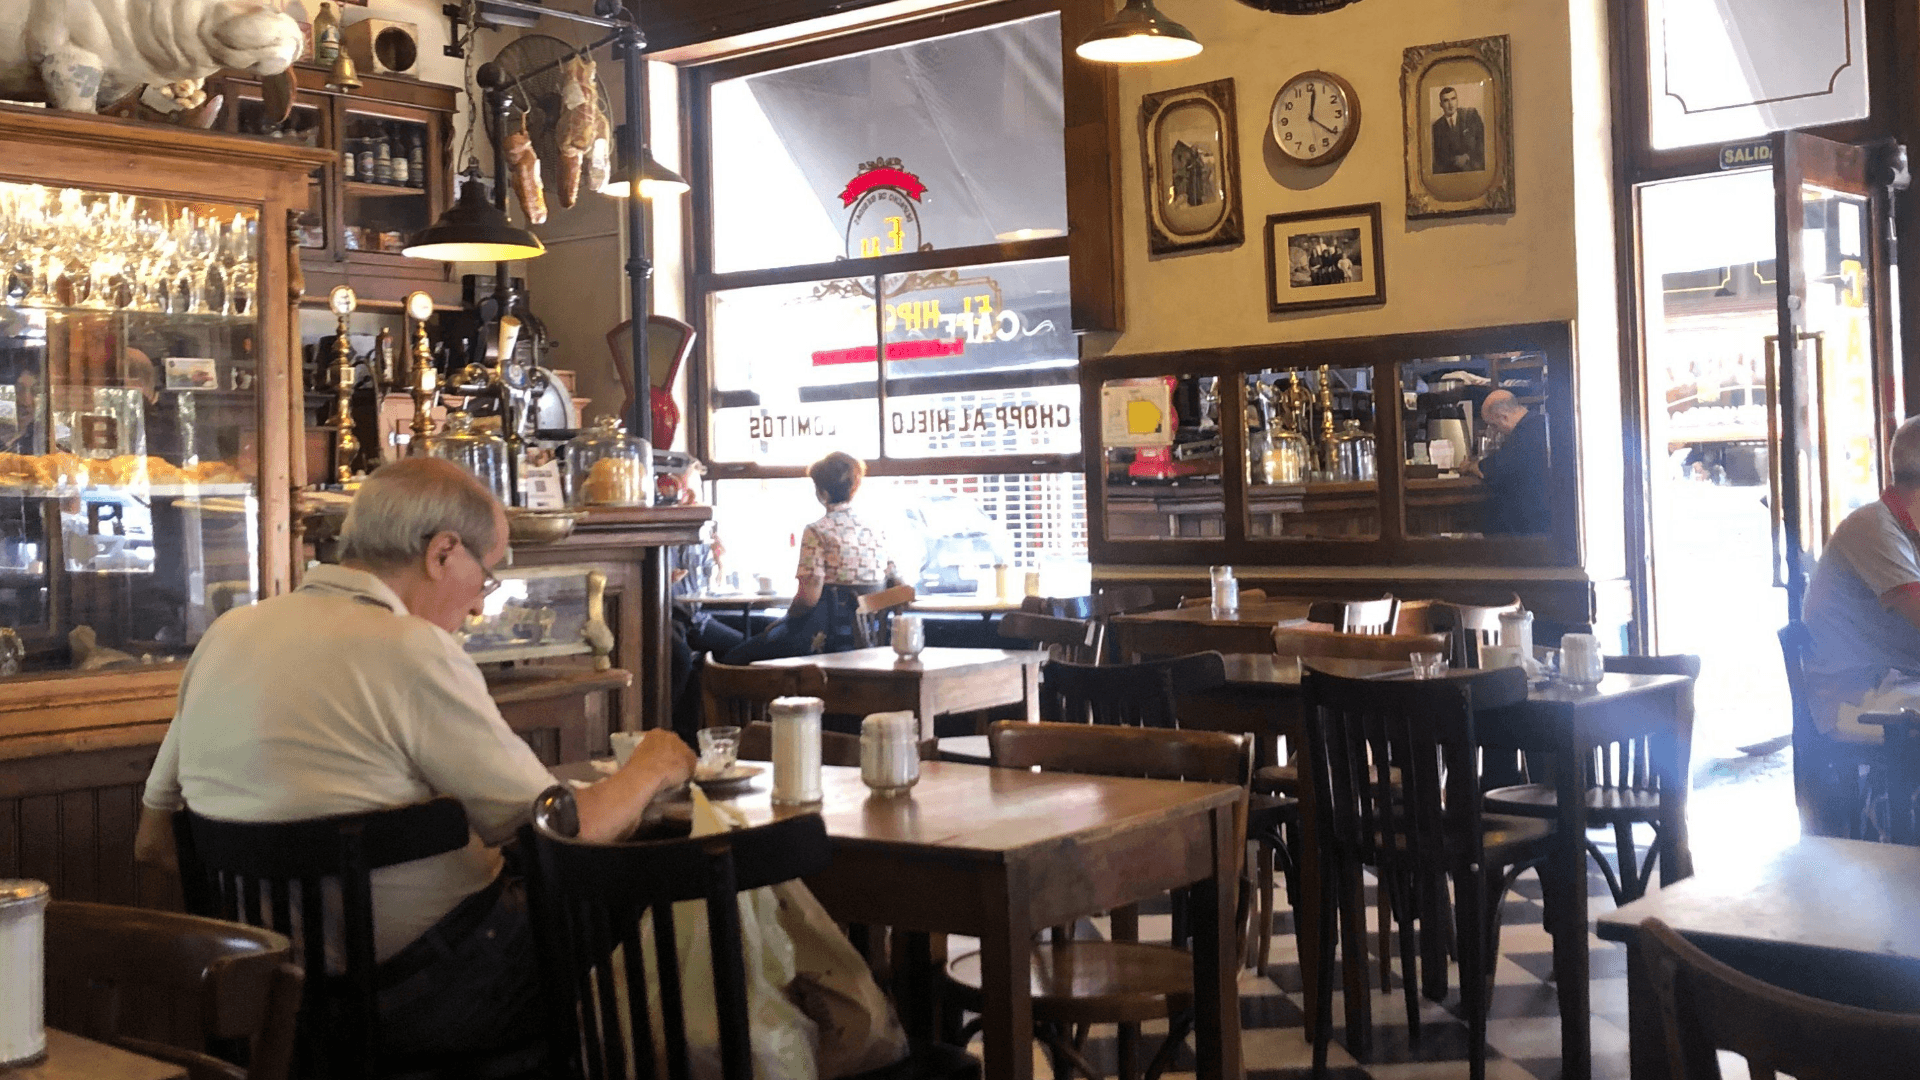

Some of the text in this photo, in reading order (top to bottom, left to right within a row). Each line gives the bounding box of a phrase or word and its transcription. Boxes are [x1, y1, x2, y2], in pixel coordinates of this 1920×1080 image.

[1306, 83, 1314, 92] 12
[1295, 89, 1302, 98] 11
[1330, 95, 1337, 104] 2
[1285, 102, 1293, 111] 10
[1334, 109, 1342, 119] 3
[1281, 117, 1289, 126] 9
[1331, 125, 1338, 134] 4
[1285, 132, 1293, 141] 8
[1295, 141, 1302, 151] 7
[1322, 137, 1330, 147] 5
[1308, 143, 1316, 153] 6
[1724, 146, 1773, 164] SALID
